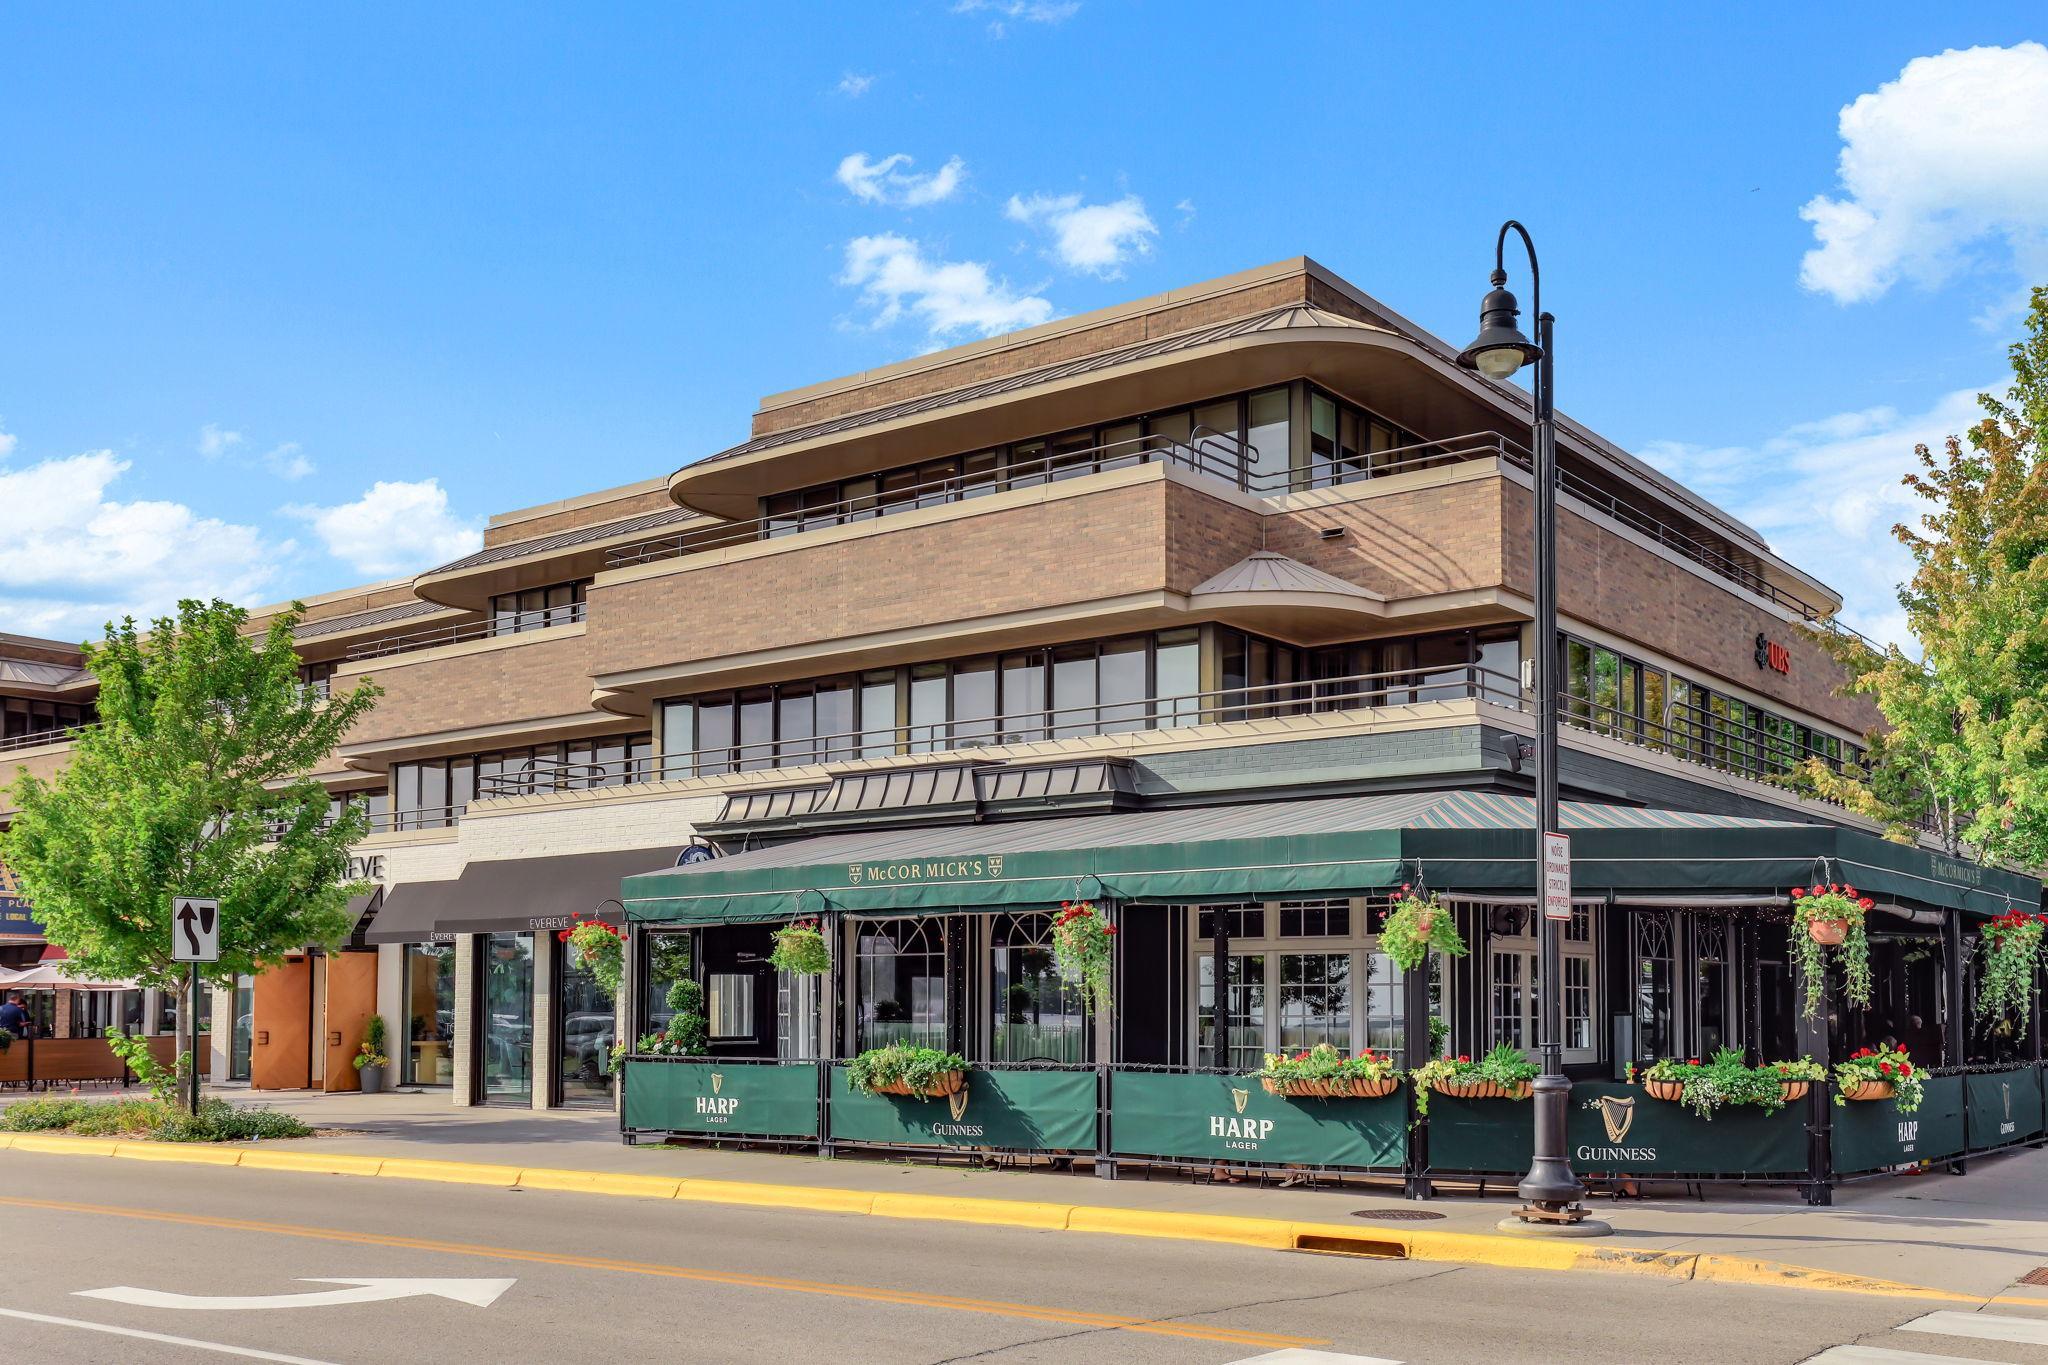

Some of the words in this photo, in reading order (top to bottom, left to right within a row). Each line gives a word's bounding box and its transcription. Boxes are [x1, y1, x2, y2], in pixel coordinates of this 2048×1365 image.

[1768, 641, 1790, 674] UBS
[1551, 845, 1563, 857] NOISE
[1547, 862, 1568, 874] ORDINANCE
[1548, 879, 1567, 891] STRICTLY
[1548, 896, 1568, 907] ENFORCED
[6, 913, 27, 921] LOCAL
[529, 917, 569, 929] EVEREVE
[696, 1096, 739, 1115] HARP
[932, 1122, 983, 1137] GUINNESS
[1210, 1116, 1275, 1140] HARP
[1898, 1121, 1919, 1142] HARP
[1226, 1140, 1258, 1150] LAGER
[1903, 1144, 1915, 1153] LAGER
[1577, 1145, 1657, 1161] GUINNESS
